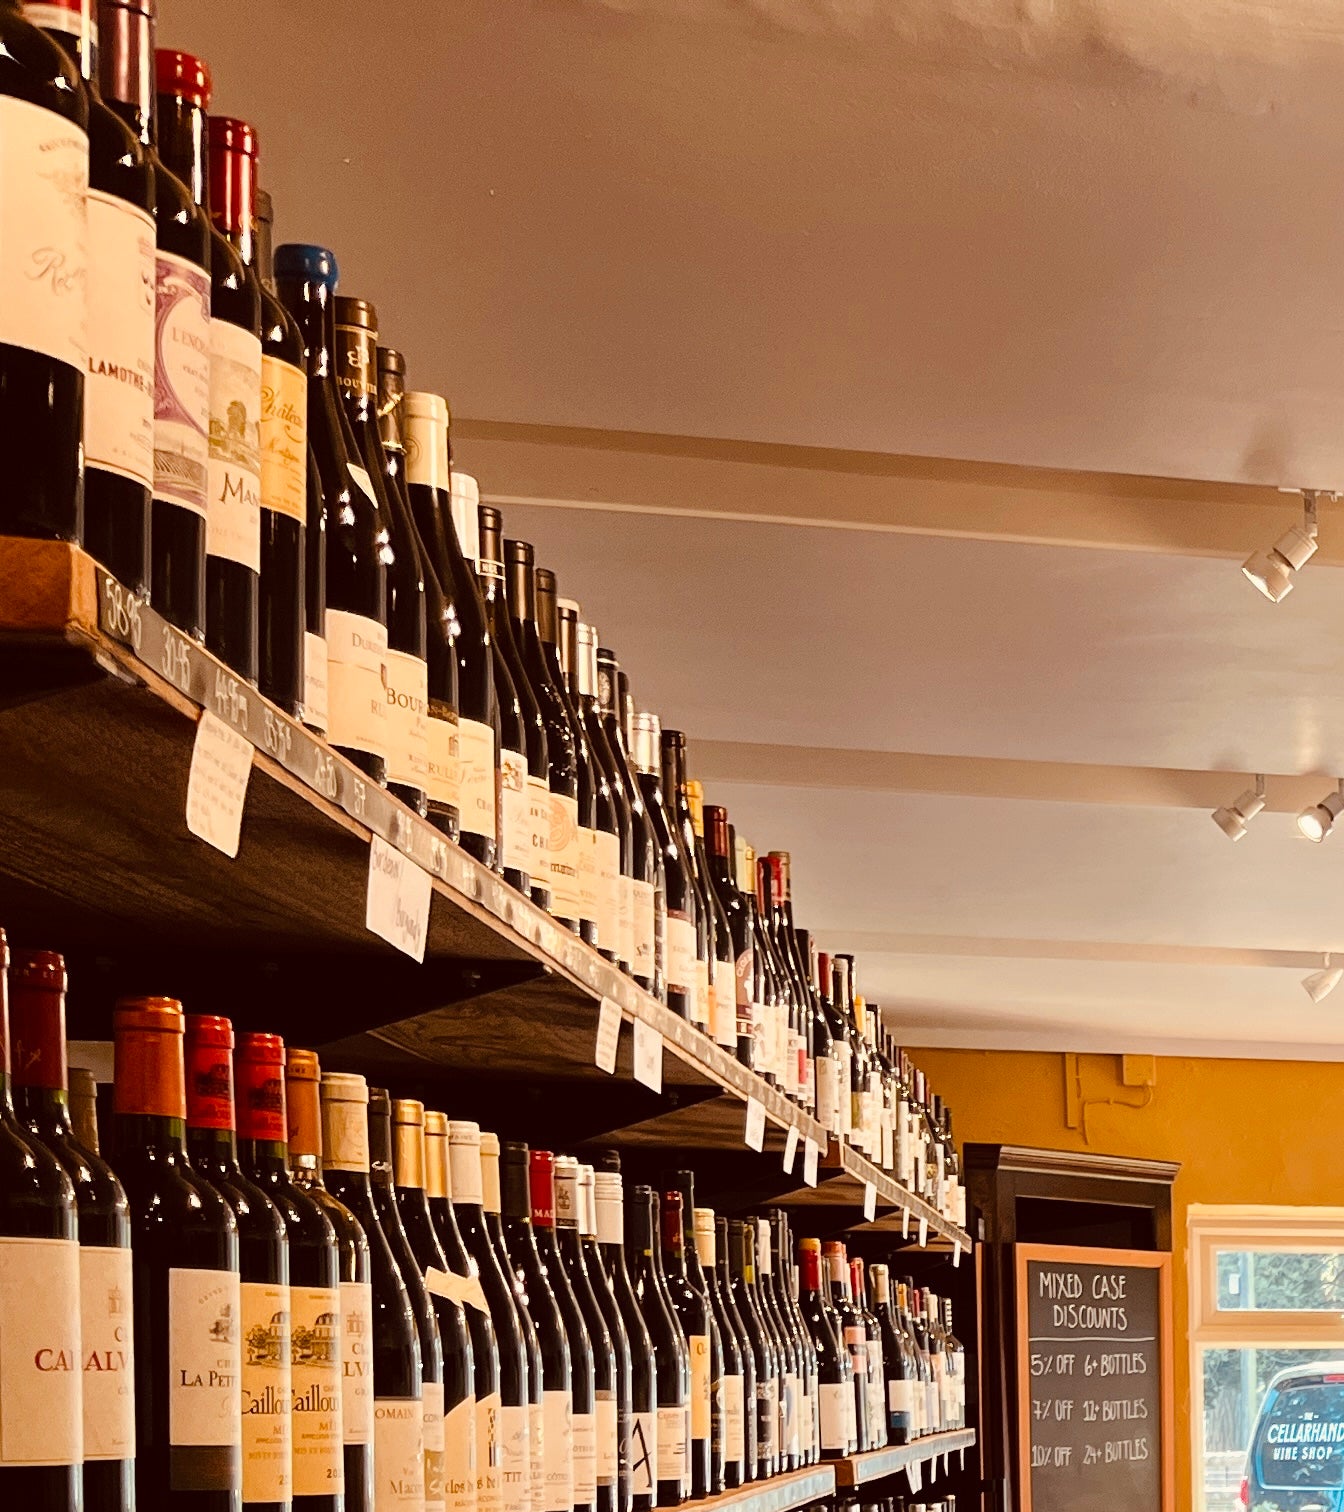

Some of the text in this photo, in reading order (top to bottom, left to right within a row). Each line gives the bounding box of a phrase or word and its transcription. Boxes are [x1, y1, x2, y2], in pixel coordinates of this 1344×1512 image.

[1040, 1271, 1127, 1300] MIXED CASE
[1053, 1304, 1128, 1331] DISCOUNTS
[1030, 1352, 1147, 1377] 5% OFF 6+ BOTTLES
[1032, 1398, 1148, 1422] 7% OFF 12+ BOTTLES
[1031, 1438, 1149, 1467] 10% OFF 24+ BOTTLES
[1273, 1446, 1333, 1461] WINE SHOP
